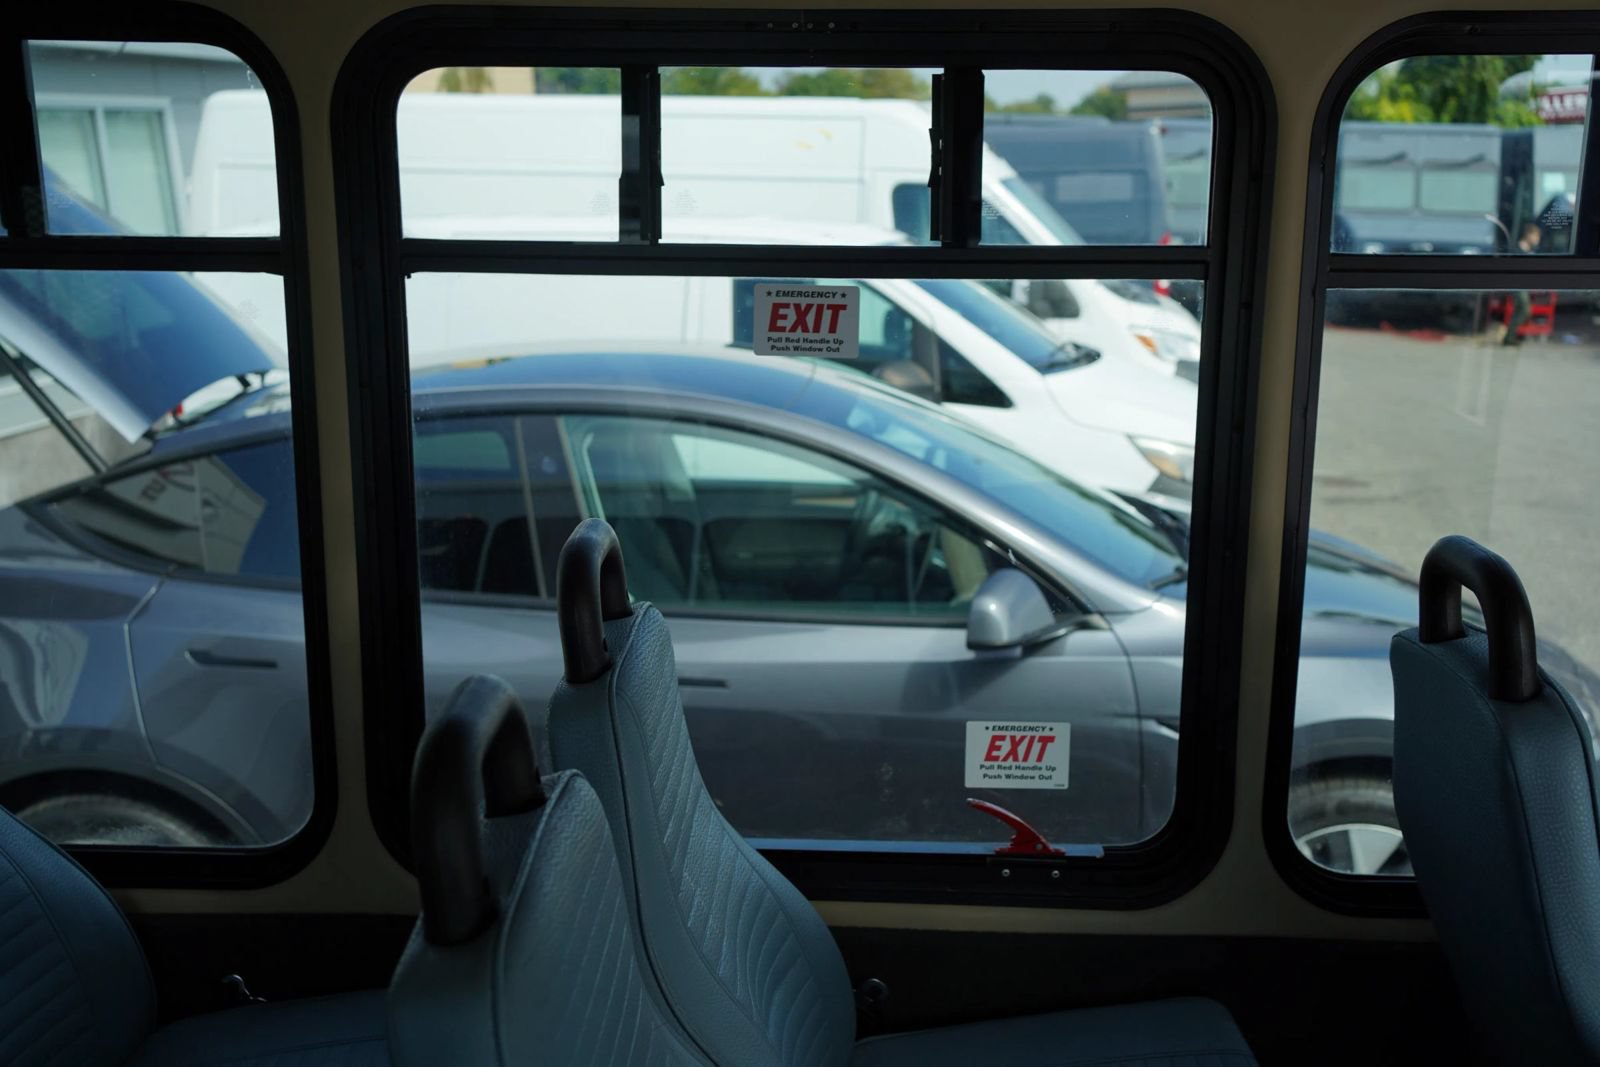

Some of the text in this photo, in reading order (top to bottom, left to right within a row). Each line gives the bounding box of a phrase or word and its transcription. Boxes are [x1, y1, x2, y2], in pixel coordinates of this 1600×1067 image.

[775, 290, 838, 299] EMERGENCY
[767, 302, 848, 334] EXIT
[767, 336, 783, 344] Pull
[833, 338, 845, 346] Up
[793, 345, 824, 353] Window
[991, 724, 1047, 733] EMERGENCY
[983, 735, 1056, 763] EXIT
[1045, 765, 1057, 773] Up
